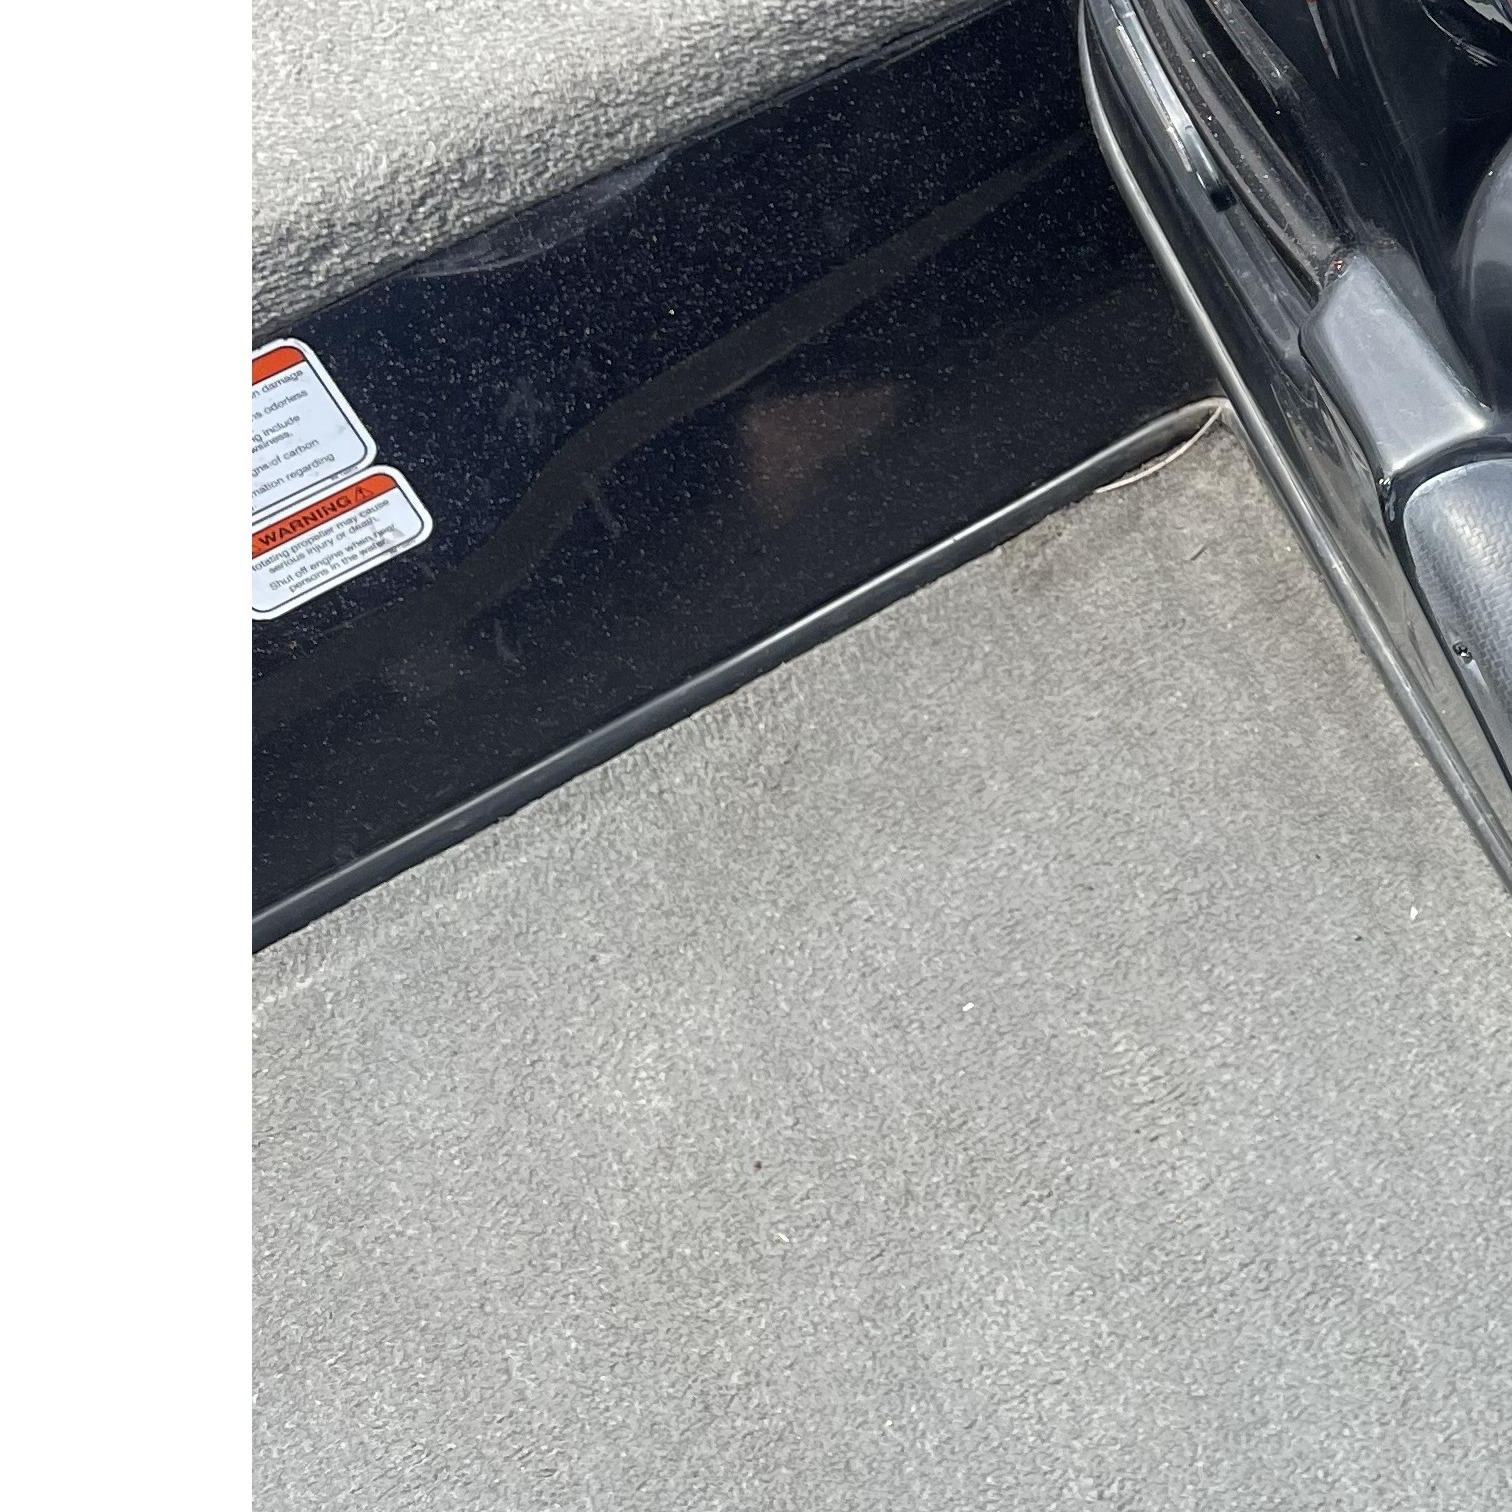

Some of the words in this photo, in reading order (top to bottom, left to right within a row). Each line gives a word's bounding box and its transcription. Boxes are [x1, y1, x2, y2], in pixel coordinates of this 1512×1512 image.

[262, 370, 304, 394] damage
[264, 390, 309, 415] odorless
[262, 415, 301, 437] include
[283, 439, 320, 460] carbon
[285, 453, 336, 481] regarding
[258, 495, 353, 546] WARNING
[335, 515, 358, 532] may
[359, 499, 390, 518] cause
[268, 553, 306, 574] serious
[306, 539, 334, 558] injury
[269, 574, 295, 591] Shut
[295, 566, 308, 578] off
[309, 551, 344, 569] engine
[289, 568, 330, 593] persons
[330, 560, 341, 571] in
[342, 553, 359, 566] the
